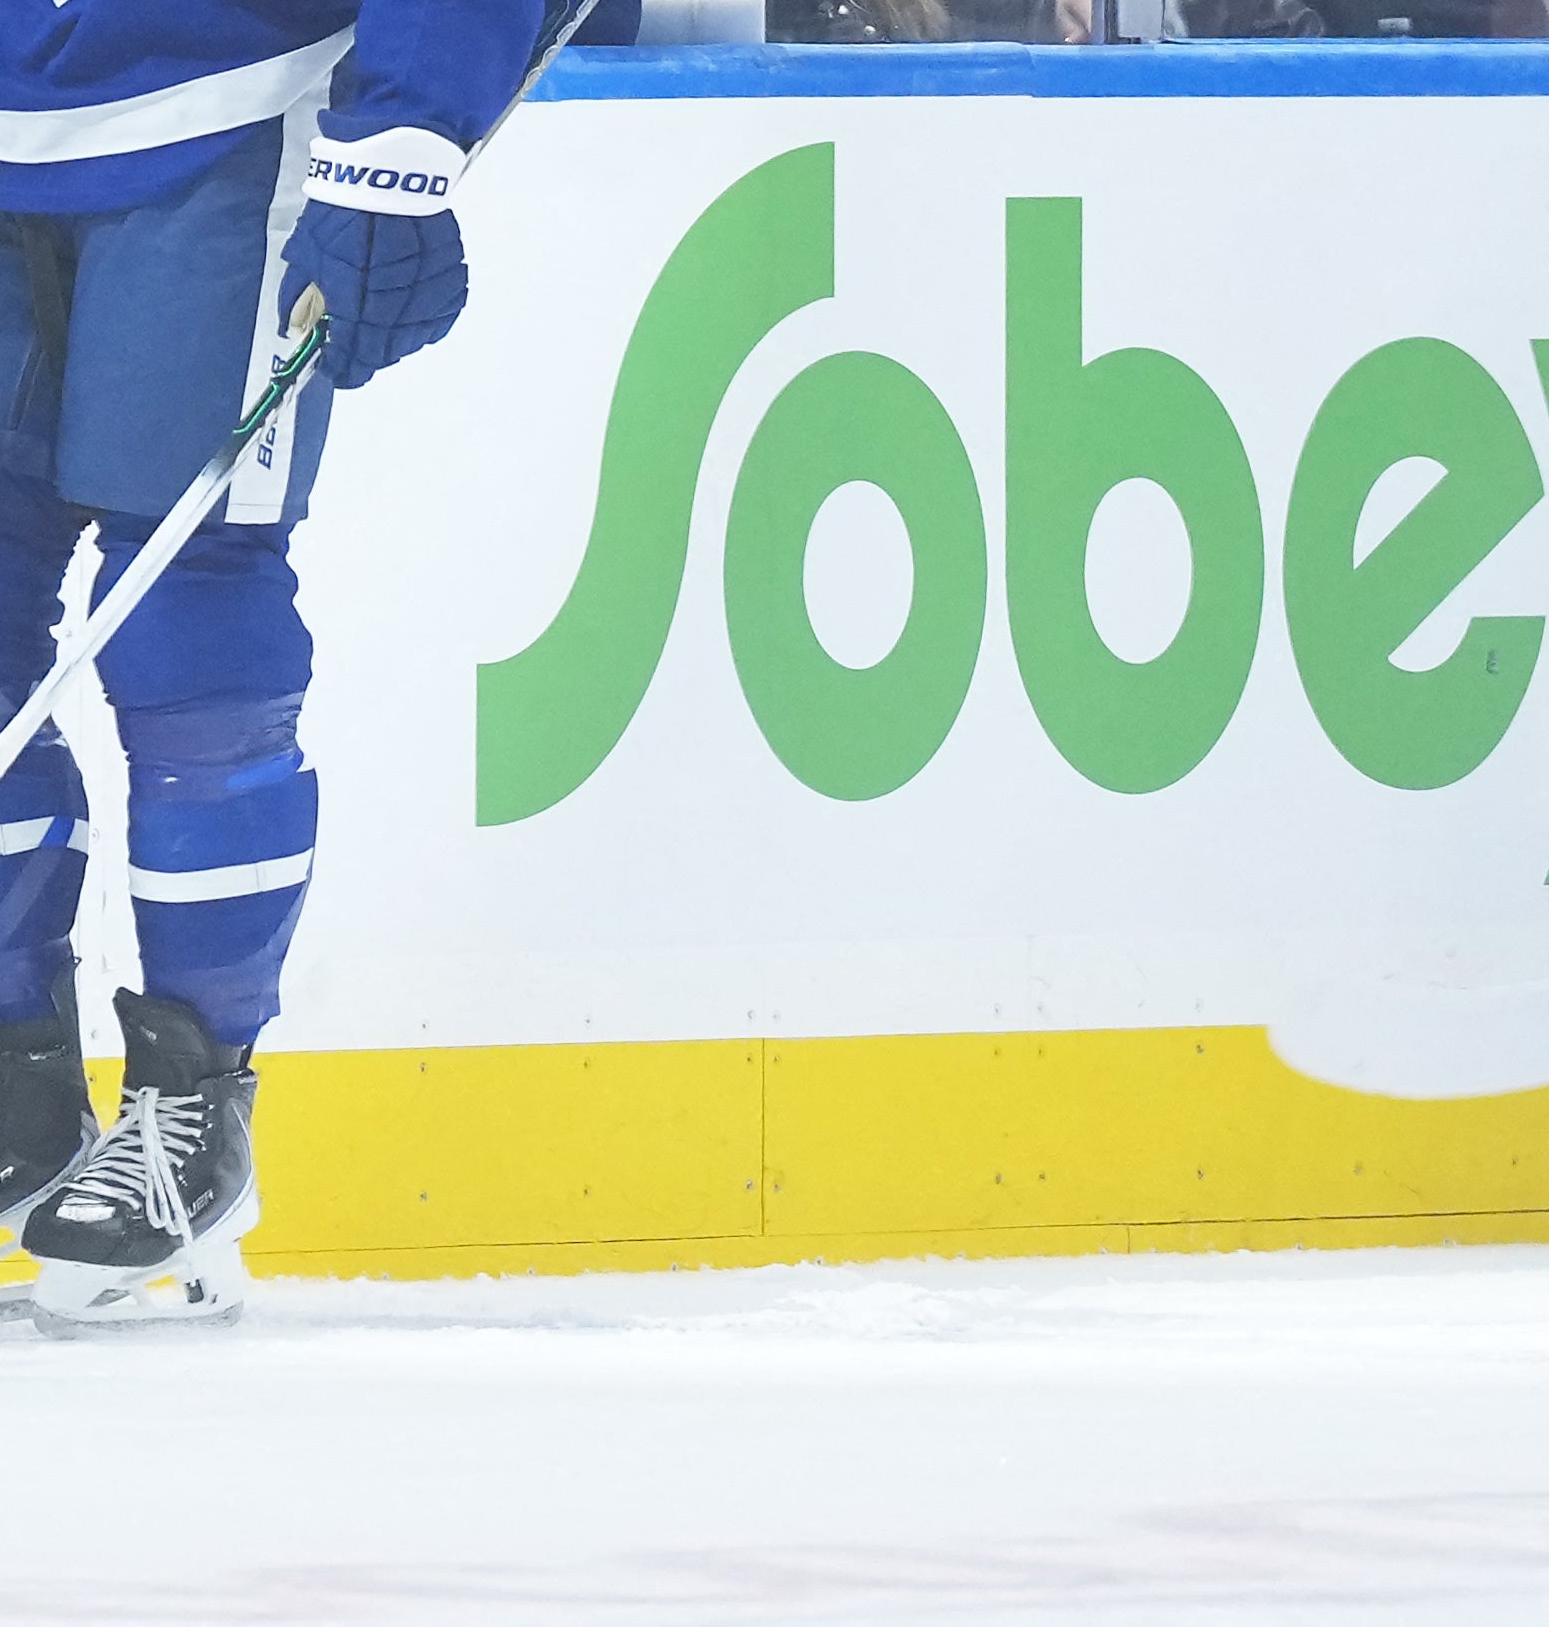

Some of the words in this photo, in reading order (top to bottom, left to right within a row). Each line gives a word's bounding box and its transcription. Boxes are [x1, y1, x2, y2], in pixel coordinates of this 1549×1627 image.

[308, 157, 449, 197] ERWOOD
[476, 140, 1549, 826] Sobe
[187, 1188, 215, 1219] UER
